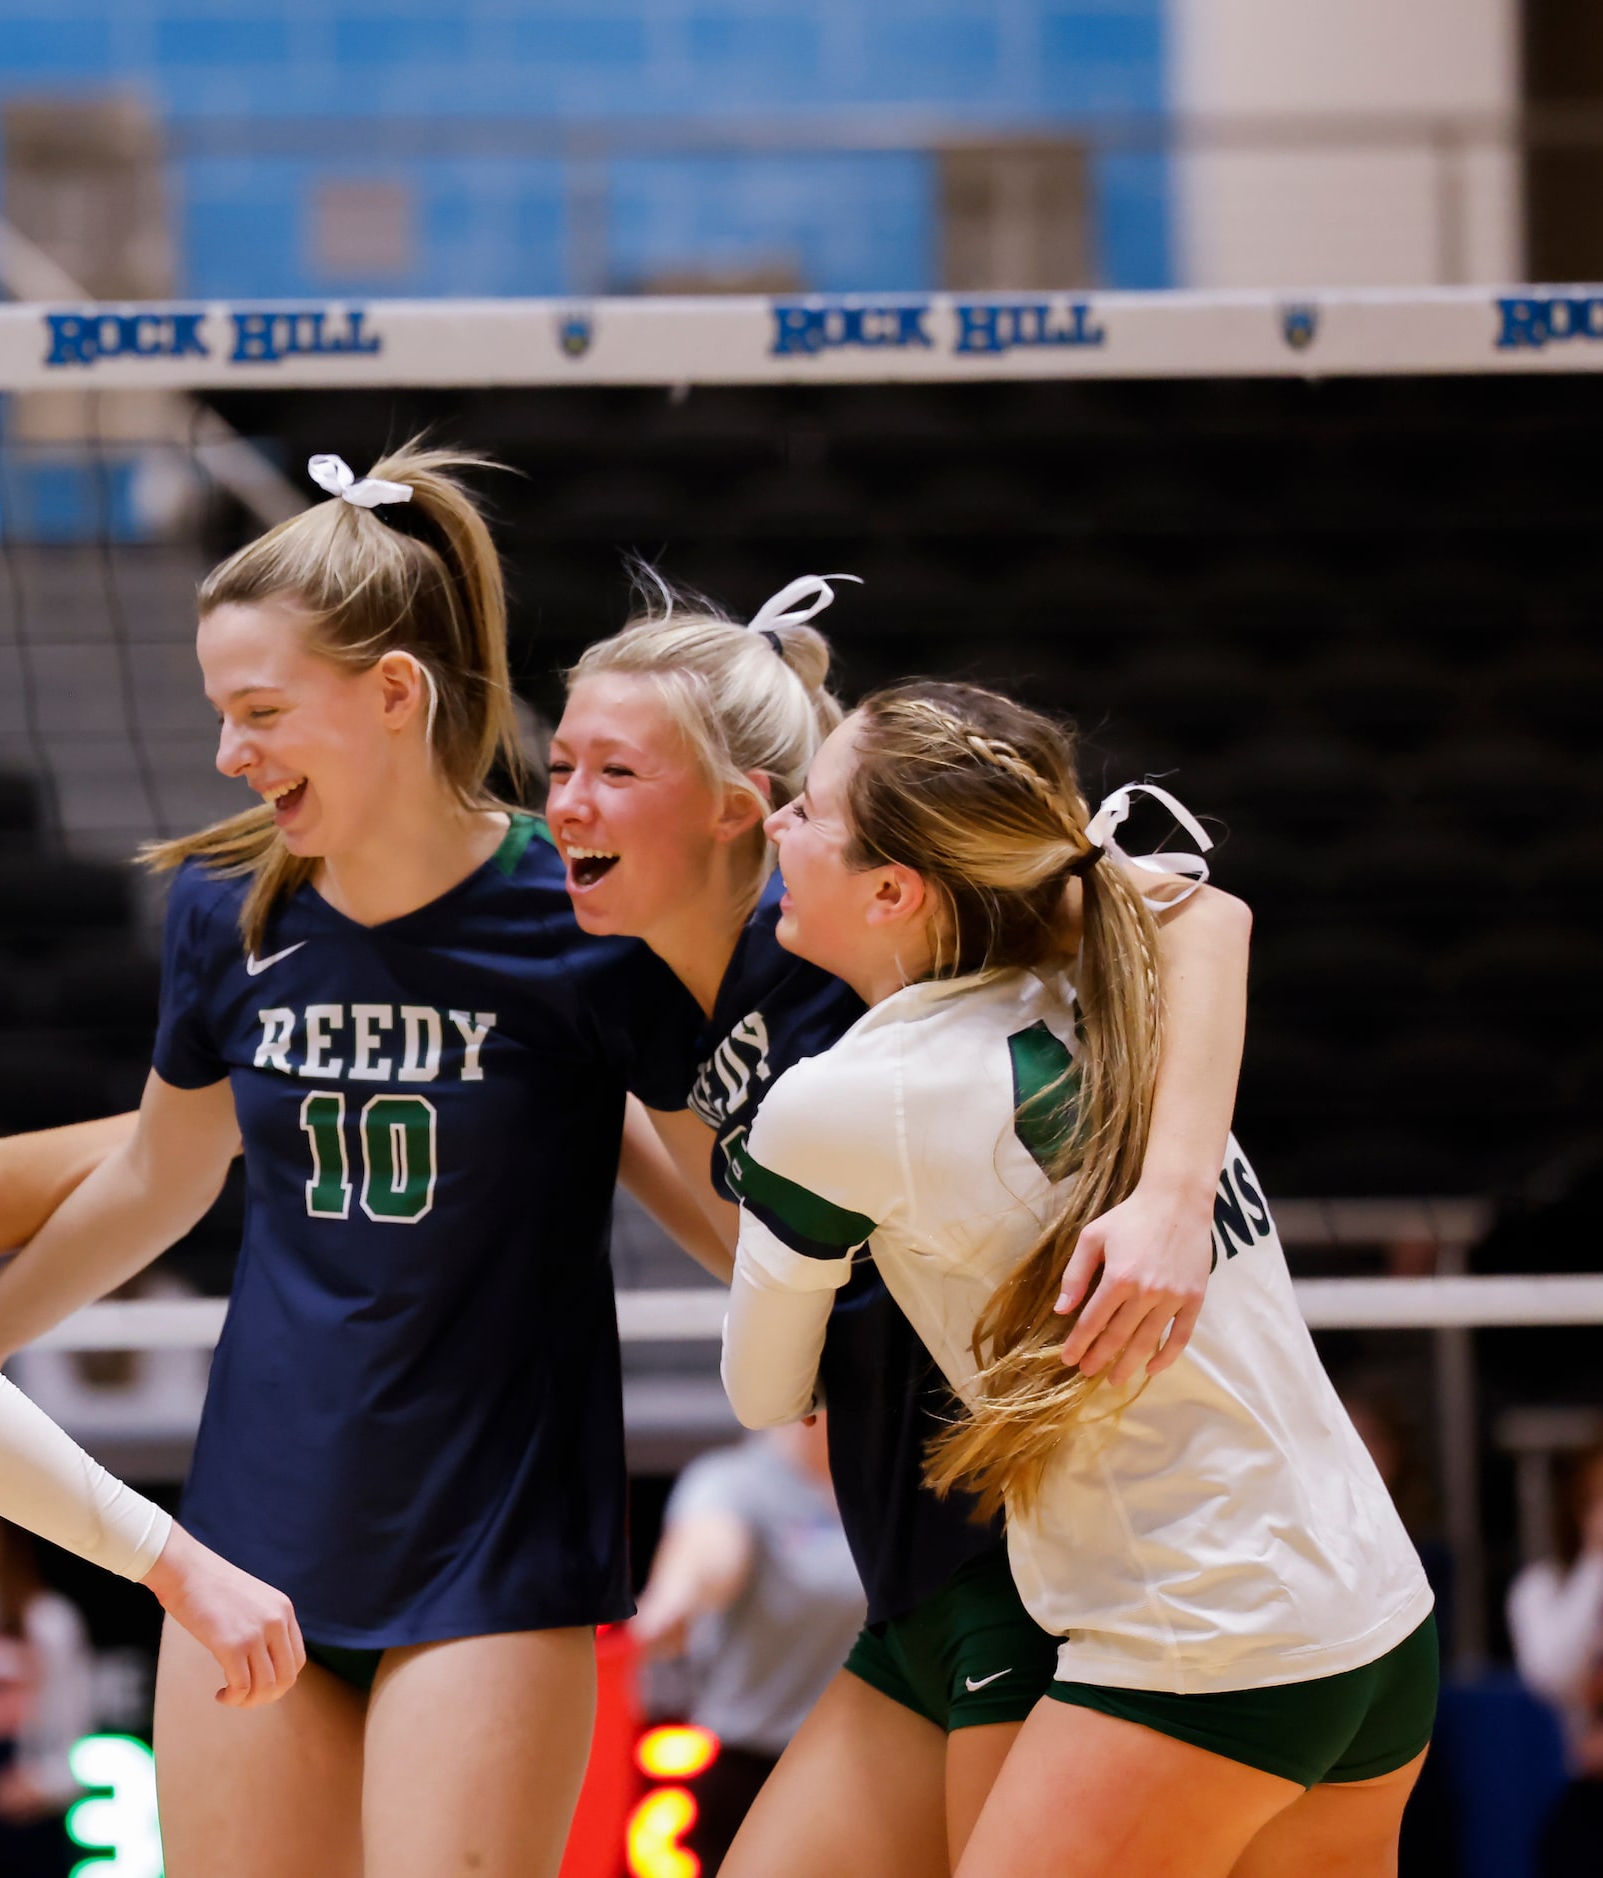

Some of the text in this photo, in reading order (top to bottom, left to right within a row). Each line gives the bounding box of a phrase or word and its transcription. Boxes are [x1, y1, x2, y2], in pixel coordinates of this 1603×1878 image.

[44, 313, 383, 365] ROCK HILL
[771, 305, 1107, 355] ROCK HILL
[253, 1003, 497, 1082] REEDY
[299, 1089, 438, 1224] 10
[1209, 1157, 1270, 1275] NS
